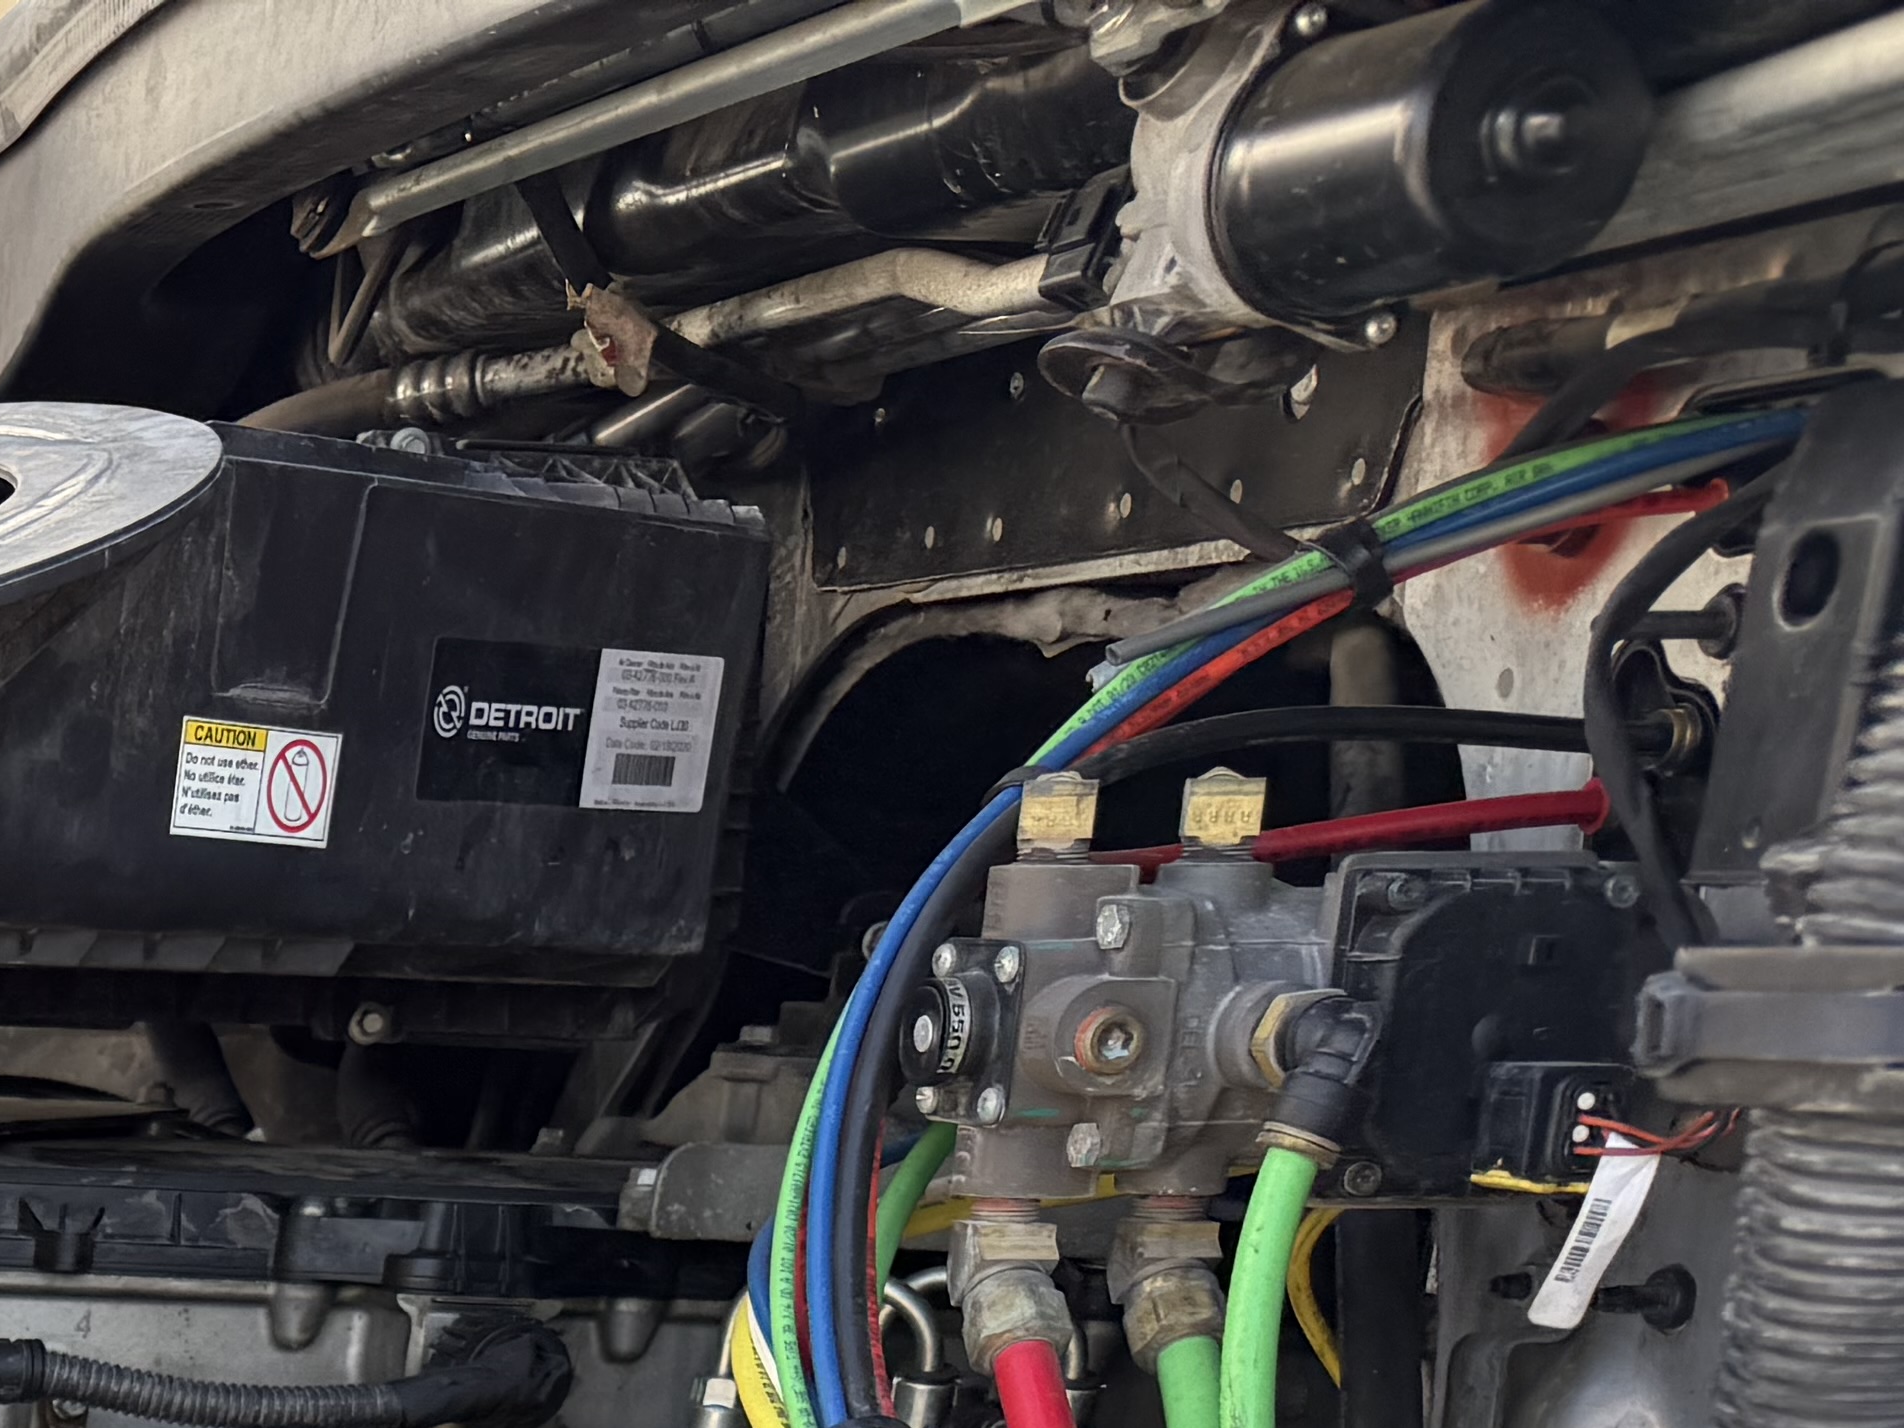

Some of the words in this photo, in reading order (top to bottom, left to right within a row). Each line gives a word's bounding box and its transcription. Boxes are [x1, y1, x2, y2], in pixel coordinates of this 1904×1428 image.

[469, 701, 581, 731] DETROIT
[194, 724, 257, 747] CAUTION
[185, 752, 199, 765] Do
[200, 754, 215, 766] not
[217, 756, 233, 769] use
[184, 769, 196, 782] No
